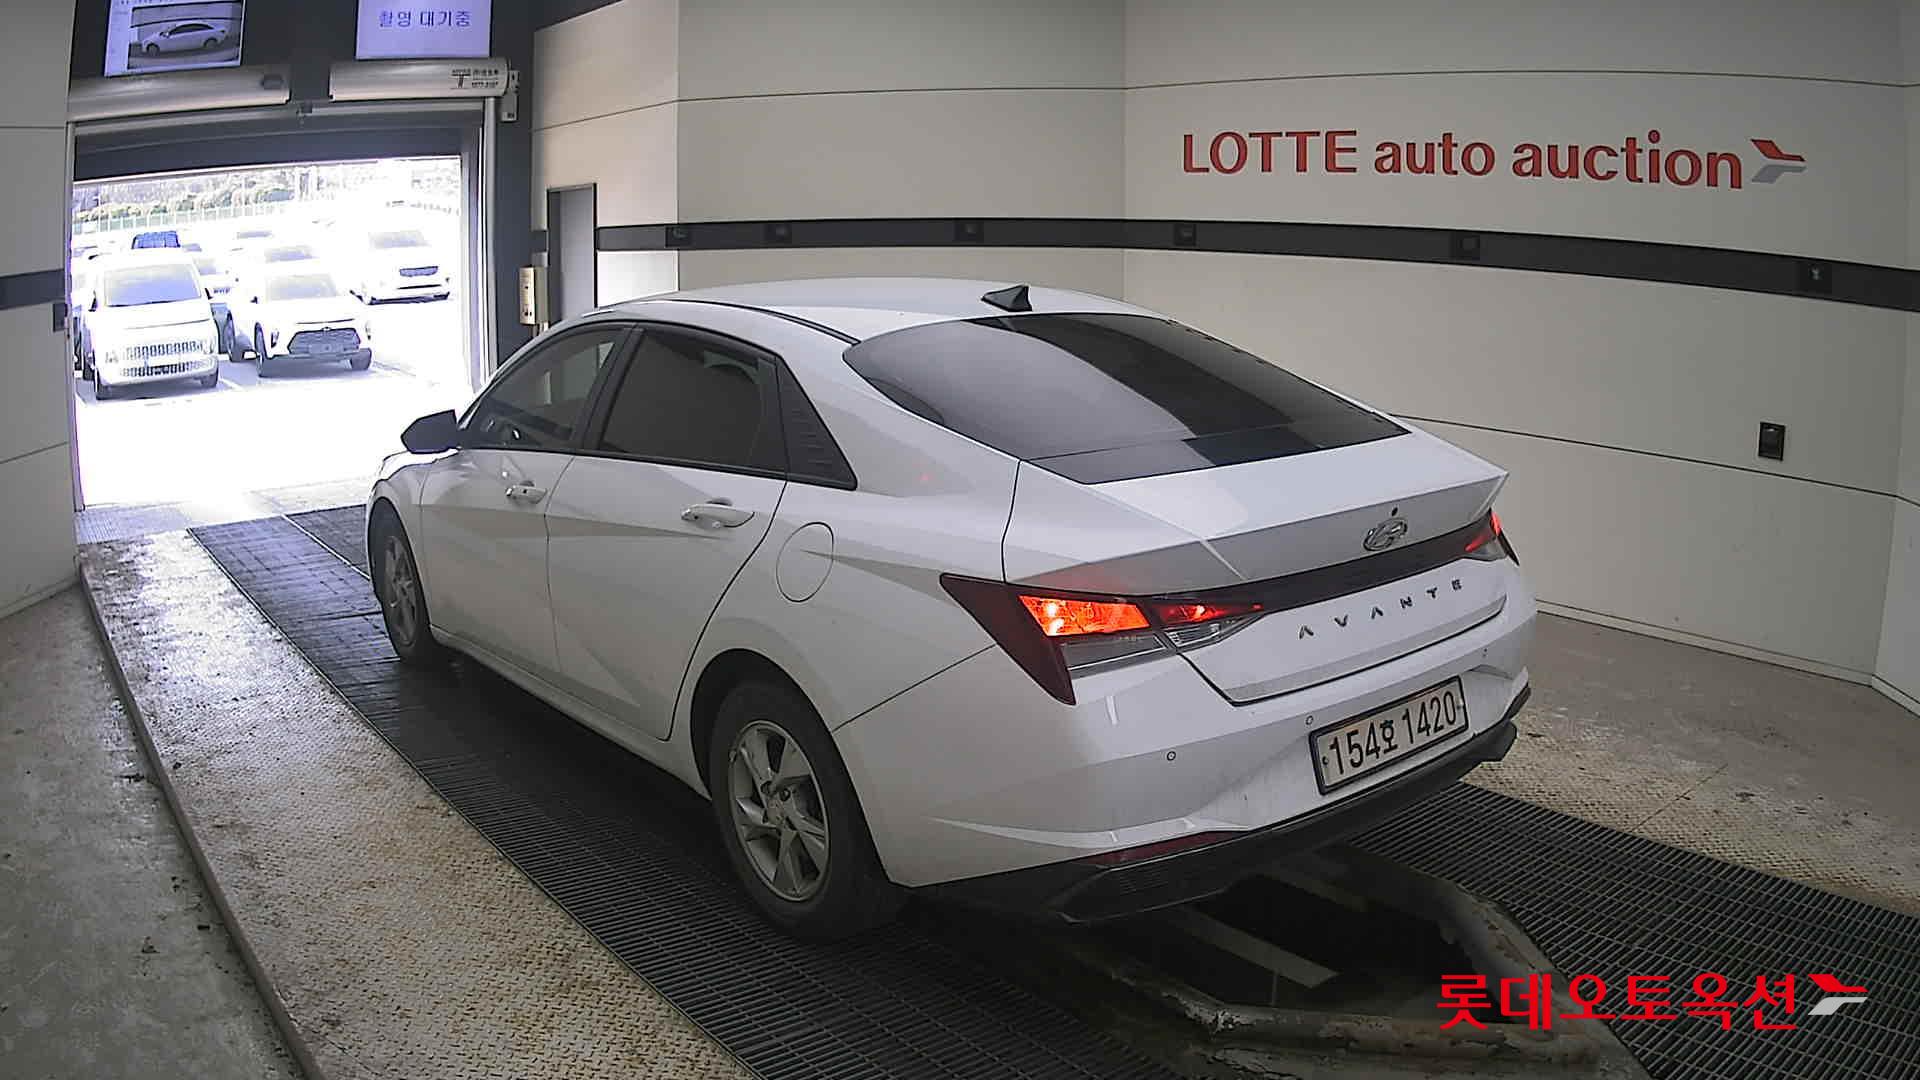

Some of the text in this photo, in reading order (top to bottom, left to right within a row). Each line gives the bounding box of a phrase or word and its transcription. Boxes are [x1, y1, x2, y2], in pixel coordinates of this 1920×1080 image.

[420, 10, 471, 28] 대기중
[1183, 129, 1744, 189] LOTTE auto auction
[1298, 578, 1463, 639] AVANTE
[1329, 691, 1457, 775] 154호 1420
